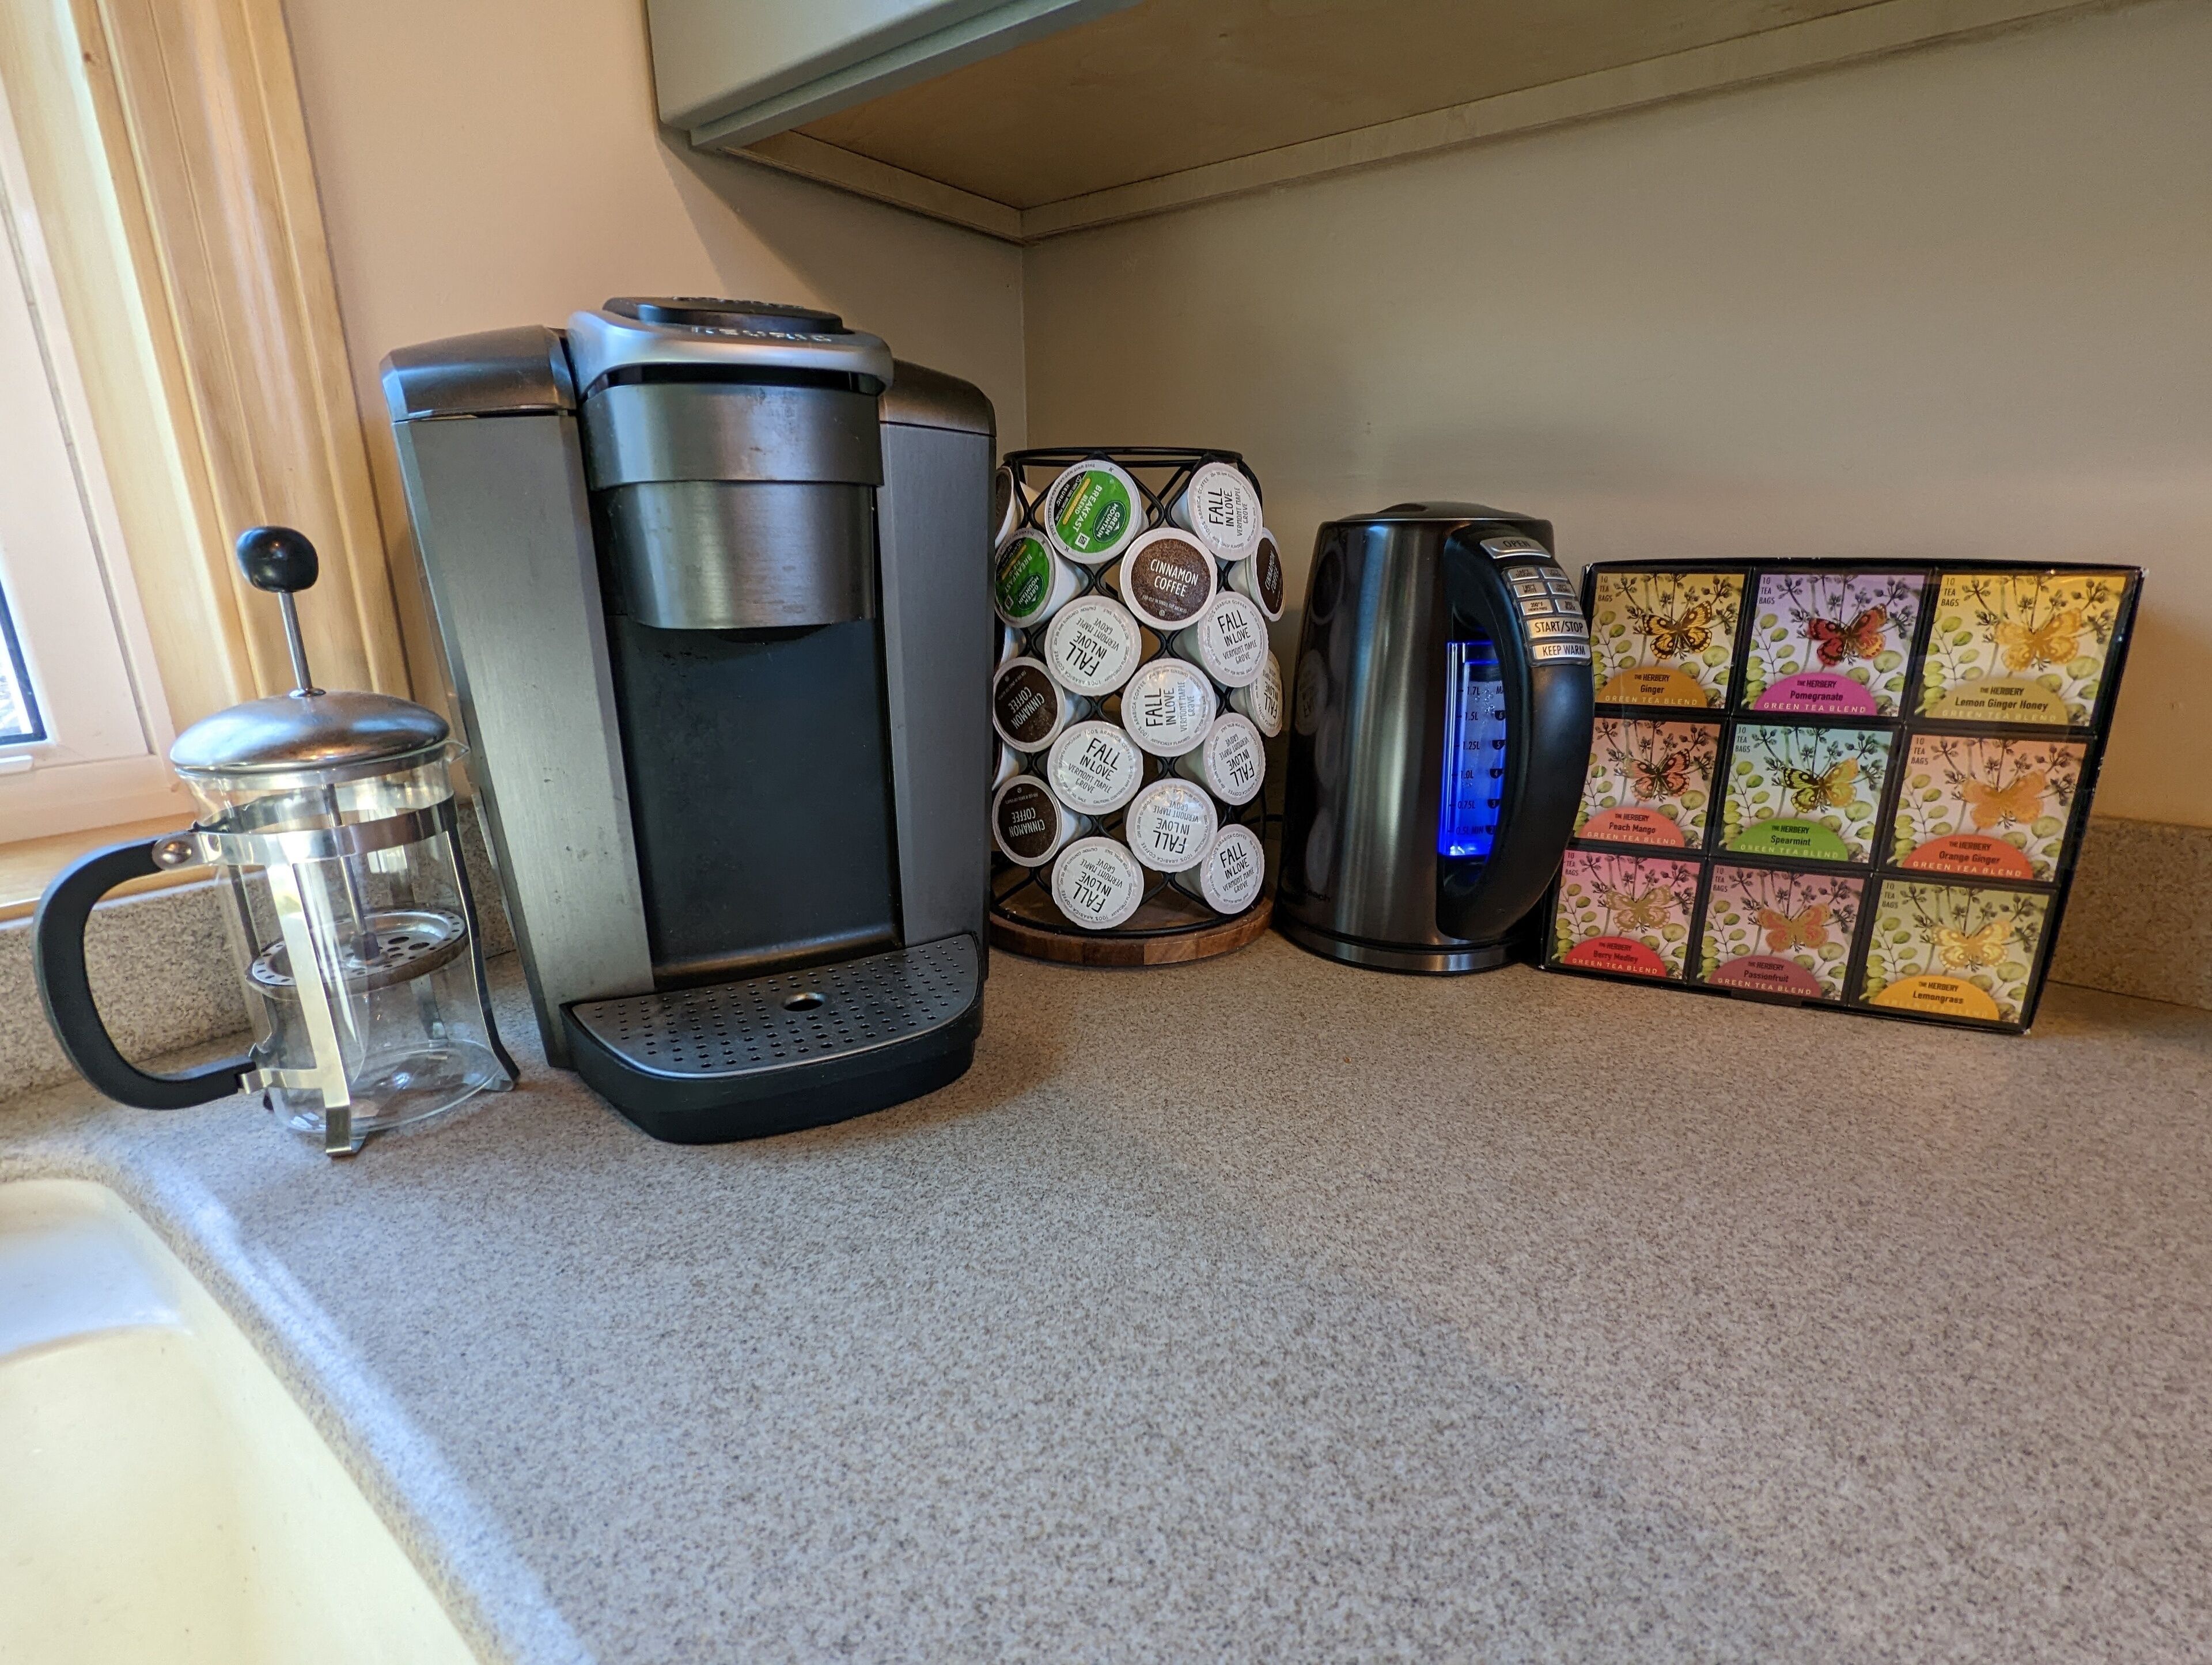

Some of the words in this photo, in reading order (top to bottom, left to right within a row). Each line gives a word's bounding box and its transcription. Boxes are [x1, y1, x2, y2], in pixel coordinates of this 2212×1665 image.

[1198, 477, 1209, 494] COFFEE
[1056, 484, 1070, 506] KEURIG
[1224, 490, 1233, 515] LOVE
[1073, 485, 1103, 533] BREAKFAST
[1075, 495, 1088, 514] BLEND
[1208, 488, 1224, 525] FALL
[1097, 503, 1119, 538] MOUNTAIN
[1105, 511, 1120, 536] GREEN
[1226, 518, 1234, 526] IN
[1005, 553, 1032, 593] BREAKFAST
[1150, 559, 1199, 586] CINNAMON
[1265, 550, 1275, 590] CINNAMON
[1154, 576, 1188, 597] COFFEE
[1271, 565, 1279, 594] COFFEE
[1946, 577, 1955, 585] 10
[1018, 576, 1039, 605] MOUNTAIN
[1025, 585, 1039, 605] GREEN
[1943, 588, 1956, 596] TEA
[1759, 597, 1775, 605] BAGS
[1941, 598, 1960, 607] BAGS
[1077, 617, 1094, 634] MAPLE
[1094, 617, 1113, 635] GROVE
[1217, 610, 1248, 634] FALL
[1535, 621, 1583, 633] START/STOP
[1073, 631, 1097, 653] LOVE
[1094, 629, 1119, 651] VERMONT
[1224, 635, 1233, 647] IN
[1233, 627, 1251, 644] LOVE
[1096, 646, 1107, 659] IN
[1222, 646, 1244, 659] VERMONT
[1245, 639, 1257, 651] MAPLE
[1543, 646, 1561, 656] KEEP
[1563, 645, 1586, 655] WARM
[1066, 641, 1100, 677] FALL
[1236, 653, 1251, 664] GROVE
[1134, 681, 1146, 700] COFFEE
[1641, 684, 1665, 695] Ginger
[1806, 680, 1837, 689] HERBERY
[1990, 687, 2025, 696] HERBERY
[1008, 687, 1032, 714] COFFEE
[1164, 688, 1176, 715] LOVE
[1790, 691, 1843, 702] Pomegranate
[1955, 696, 1985, 708] Lemon
[1987, 699, 2017, 710] Ginger
[2020, 700, 2048, 711] Honey
[1011, 693, 1045, 730] CINNAMON
[1145, 688, 1163, 727] FALL
[1264, 693, 1278, 719] FALL
[1764, 702, 1800, 710] GREEN
[1805, 704, 1824, 712] TEA
[1829, 705, 1866, 713] BLEND
[1166, 717, 1176, 725] IN
[1179, 703, 1187, 733] VERMONT
[1465, 712, 1478, 720] 1.5L
[1100, 730, 1121, 743] ARABICA
[1463, 741, 1480, 750] 1.25L
[1086, 738, 1120, 771] FALL
[1226, 753, 1244, 771] LOVE
[1242, 749, 1250, 760] IN
[1911, 757, 1929, 765] BAGS
[1080, 754, 1091, 768] IN
[1090, 761, 1114, 781] LOVE
[1230, 760, 1255, 787] FALL
[1461, 770, 1474, 779] 1.0L
[1069, 763, 1094, 783] VERMONT
[1094, 779, 1112, 794] MAPLE
[1075, 779, 1096, 794] GROVE
[1153, 805, 1171, 816] MAPLE
[1170, 800, 1188, 811] GROVE
[1457, 801, 1475, 809] 0.75L
[1012, 807, 1036, 823] COFFEE
[1172, 810, 1198, 822] VERMONT
[1623, 813, 1650, 821] HERBERY
[1009, 819, 1045, 837] CINNAMON
[1156, 818, 1180, 833] LOVE
[1180, 824, 1190, 835] IN
[1471, 826, 1484, 834] MIN
[1609, 822, 1630, 831] Peach
[1632, 824, 1656, 834] Mango
[1780, 826, 1810, 834] HERBERY
[1153, 830, 1187, 854] FALL
[1587, 831, 1618, 840] GREEN
[1644, 837, 1676, 845] BLEND
[1771, 835, 1811, 846] Spearmint
[1220, 843, 1247, 868] FALL
[1740, 844, 1775, 852] GREEN
[1780, 848, 1798, 856] TEA
[1803, 849, 1839, 859] BLEND
[1939, 850, 1969, 862] Orange
[1972, 854, 2000, 866] Ginger
[1080, 858, 1098, 873] MAPLE
[1096, 858, 1115, 874] GROVE
[1225, 868, 1233, 879] IN
[1233, 857, 1249, 875] LOVE
[1715, 867, 1725, 875] 10
[1912, 860, 1951, 870] GREEN
[1956, 864, 1977, 874] TEA
[1982, 867, 2022, 877] BLEND
[1078, 871, 1102, 891] LOVE
[1097, 869, 1123, 888] VERMONT
[1222, 875, 1243, 892] VERMONT
[1243, 867, 1255, 879] MAPLE
[1100, 884, 1112, 897] IN
[1234, 881, 1248, 893] GROVE
[1713, 884, 1728, 893] BAGS
[1073, 881, 1106, 913] FALL
[1882, 901, 1899, 909] BAGS
[1593, 950, 1612, 961] Berry
[1613, 953, 1638, 964] Medley
[1572, 958, 1603, 967] GREEN
[1627, 965, 1658, 974] BLEND
[1757, 962, 1784, 971] HERBERY
[1744, 970, 1789, 983] Passionfruit
[1718, 978, 1751, 987] GREEN
[1755, 983, 1774, 991] TEA
[1777, 985, 1812, 995] BLEND
[1928, 982, 1959, 992] HERBERY
[1913, 991, 1964, 1005] Lemongrass
